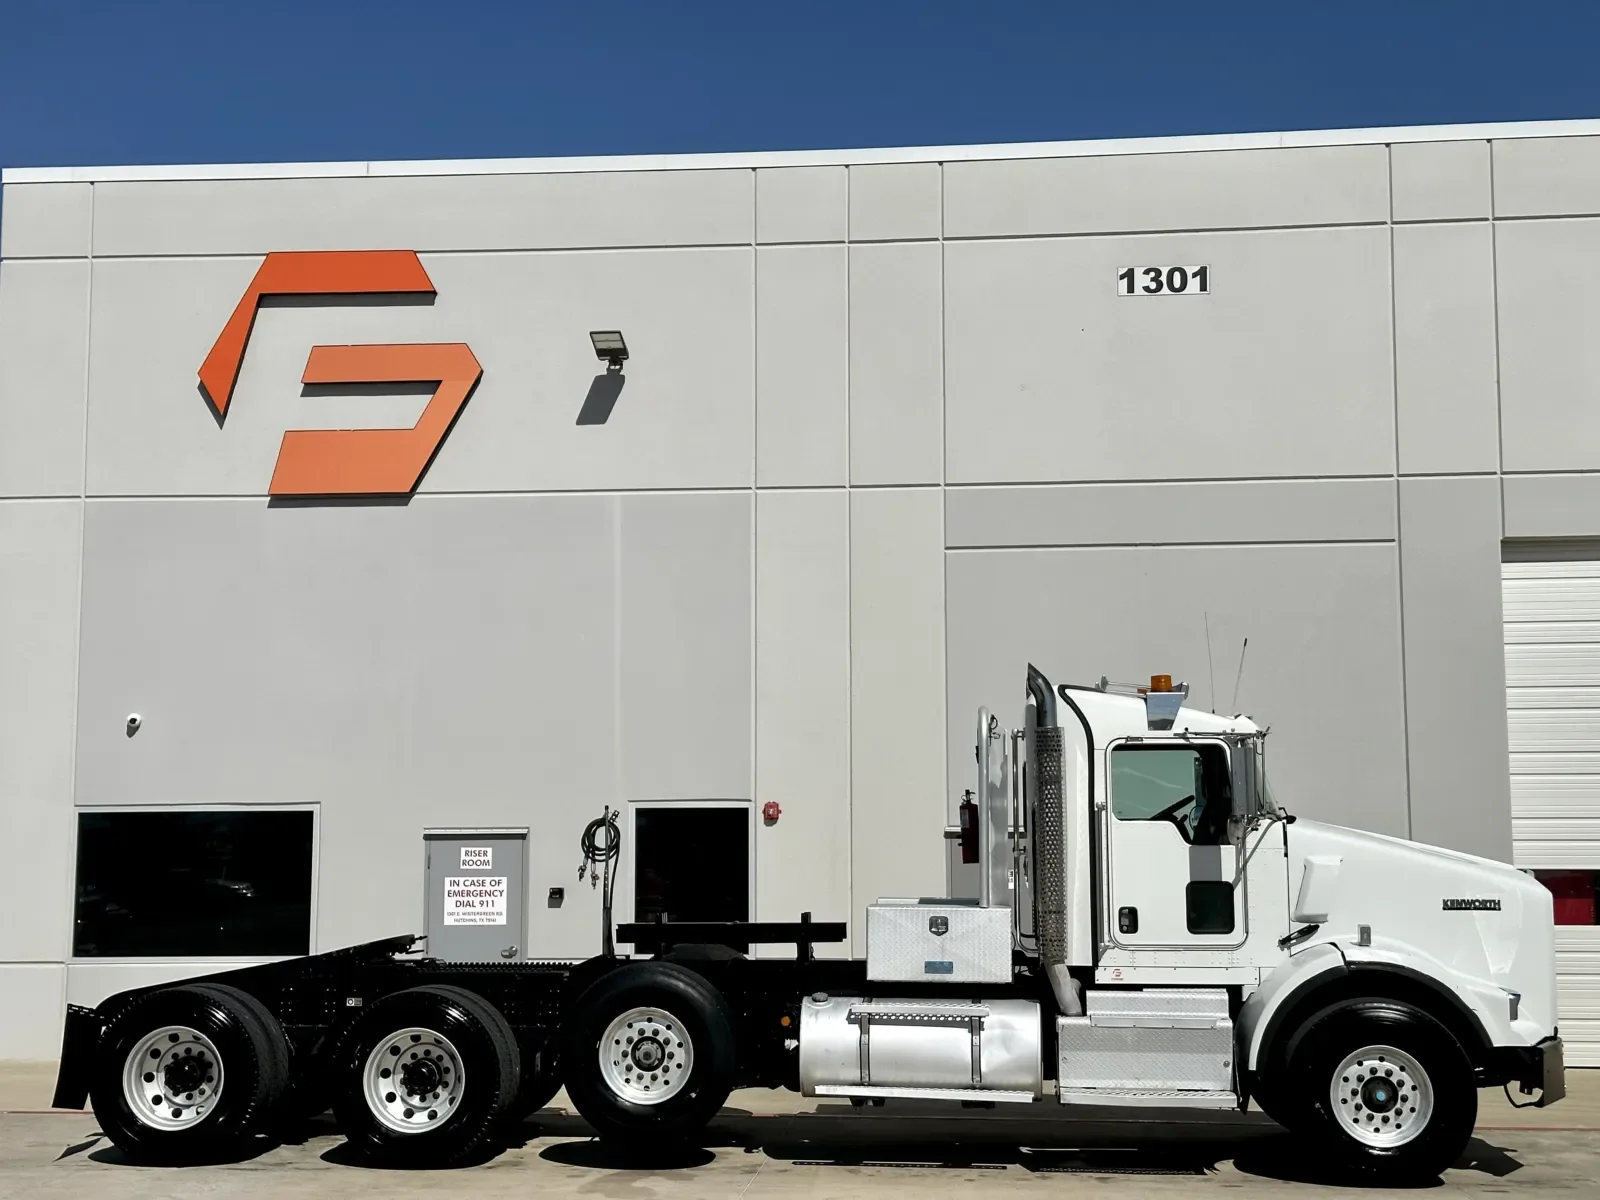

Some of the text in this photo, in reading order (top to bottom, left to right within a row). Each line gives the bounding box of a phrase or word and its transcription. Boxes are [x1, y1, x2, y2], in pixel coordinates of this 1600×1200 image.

[1119, 265, 1208, 294] 1301
[464, 849, 488, 858] RISER
[462, 859, 490, 867] ROOM
[449, 879, 503, 887] IN CASE OF
[447, 889, 504, 898] EMERGENCY
[455, 899, 495, 908] DIAL 911
[1442, 898, 1501, 911] KENWORTH
